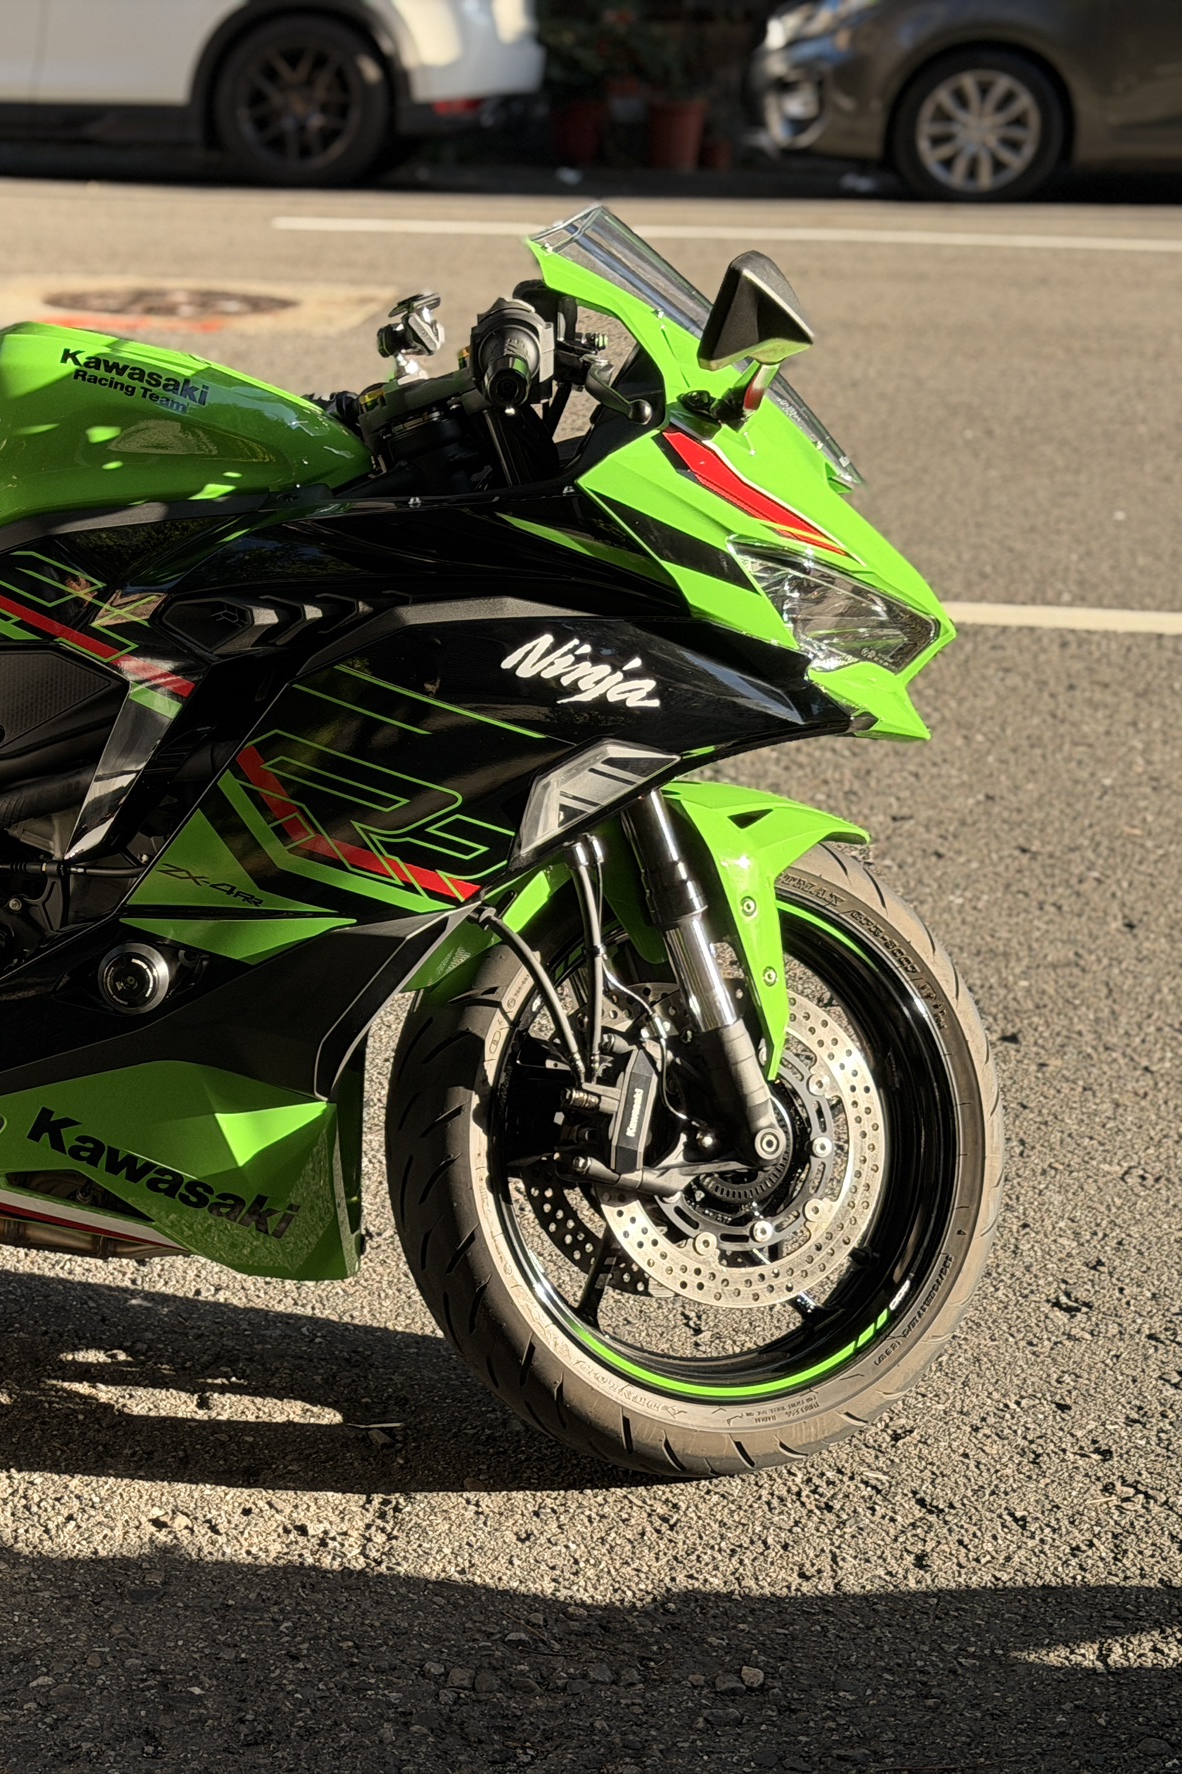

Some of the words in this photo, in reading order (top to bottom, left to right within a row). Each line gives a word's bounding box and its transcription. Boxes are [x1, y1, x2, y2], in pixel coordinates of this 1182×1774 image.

[60, 348, 210, 406] Kawasaki
[73, 369, 136, 397] Racing
[140, 386, 188, 414] Team
[500, 633, 661, 707] Ninja
[625, 1088, 644, 1138] Kawasaki
[26, 1106, 301, 1239] Kawasaki
